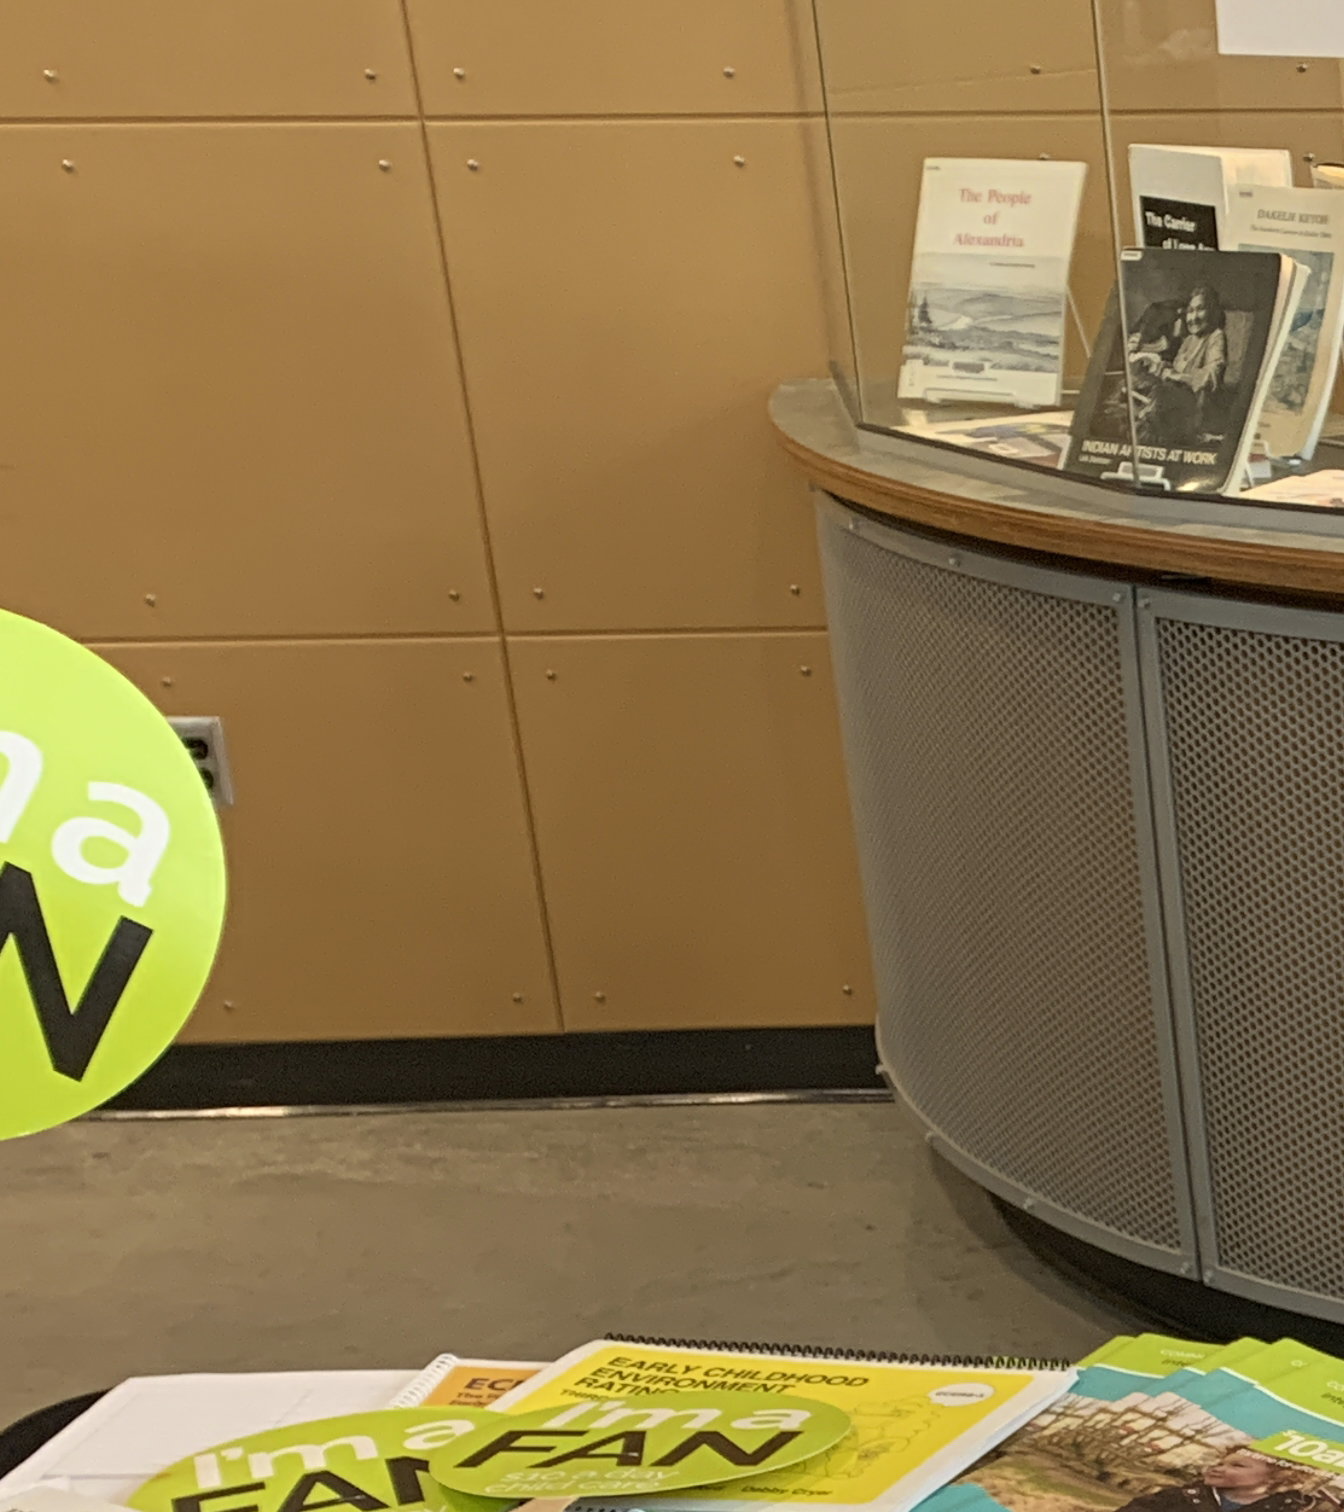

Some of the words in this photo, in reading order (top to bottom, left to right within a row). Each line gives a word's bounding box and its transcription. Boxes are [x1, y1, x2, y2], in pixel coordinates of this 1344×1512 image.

[959, 188, 982, 202] The
[988, 189, 1032, 206] People
[984, 212, 1000, 224] of
[1146, 211, 1162, 227] The
[1164, 214, 1197, 232] Carrier
[953, 233, 1025, 248] Alexandria
[1082, 440, 1119, 455] INDIAN
[1168, 450, 1182, 461] AT
[1184, 452, 1218, 465] WORK
[591, 1368, 796, 1394] ENVIRONMENT
[608, 1357, 703, 1374] EARLY
[703, 1366, 869, 1387] CHILDHOOD
[542, 1401, 722, 1429] I'm
[730, 1409, 811, 1429] a
[453, 1430, 804, 1468] FAN
